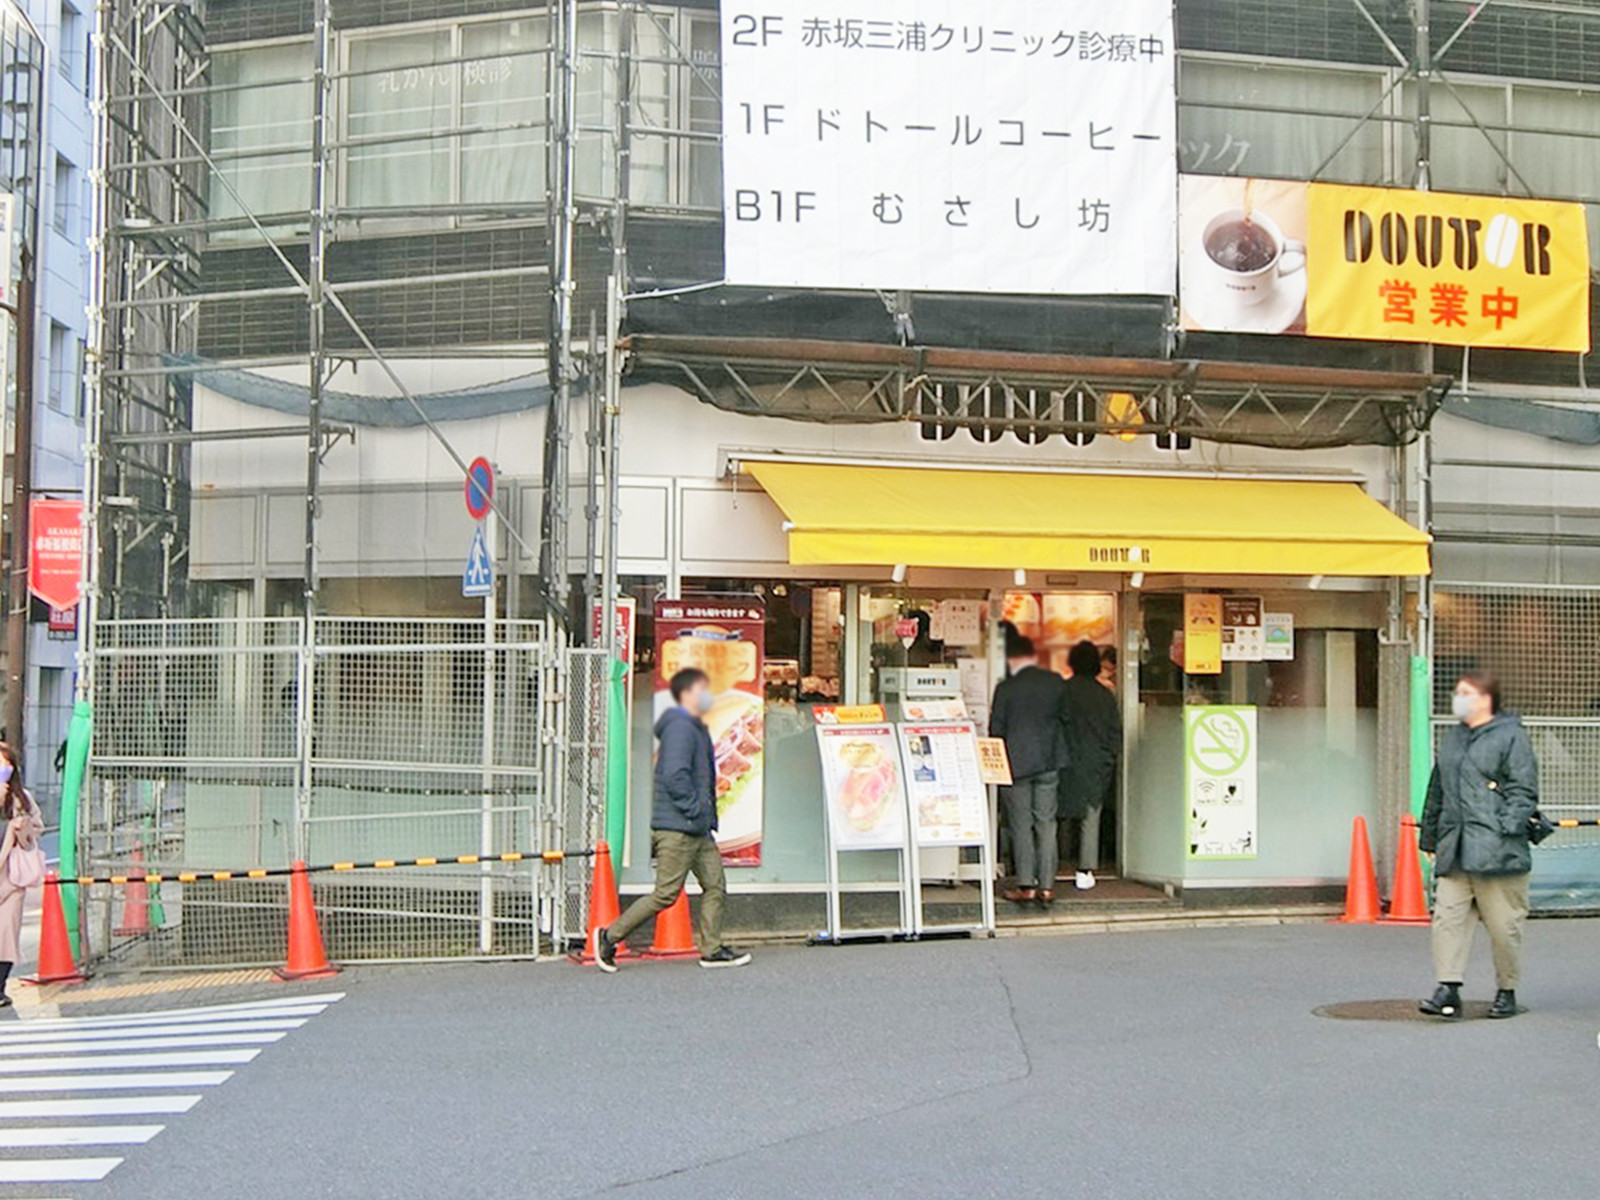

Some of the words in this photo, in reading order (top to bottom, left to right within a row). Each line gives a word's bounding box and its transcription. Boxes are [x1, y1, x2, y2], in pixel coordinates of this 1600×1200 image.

[732, 14, 784, 47] 2F
[801, 18, 1165, 64] 赤坂三浦クリニック診療中
[377, 57, 513, 93] 乳がん検診
[740, 103, 785, 135] 1F
[816, 108, 1161, 151] ドトールコーヒー
[735, 189, 817, 223] B1F
[872, 192, 1111, 234] むさし坊
[1344, 209, 1551, 276] DOUTOR
[1378, 280, 1519, 331] 営業中
[1089, 546, 1150, 563] DOUTOR
